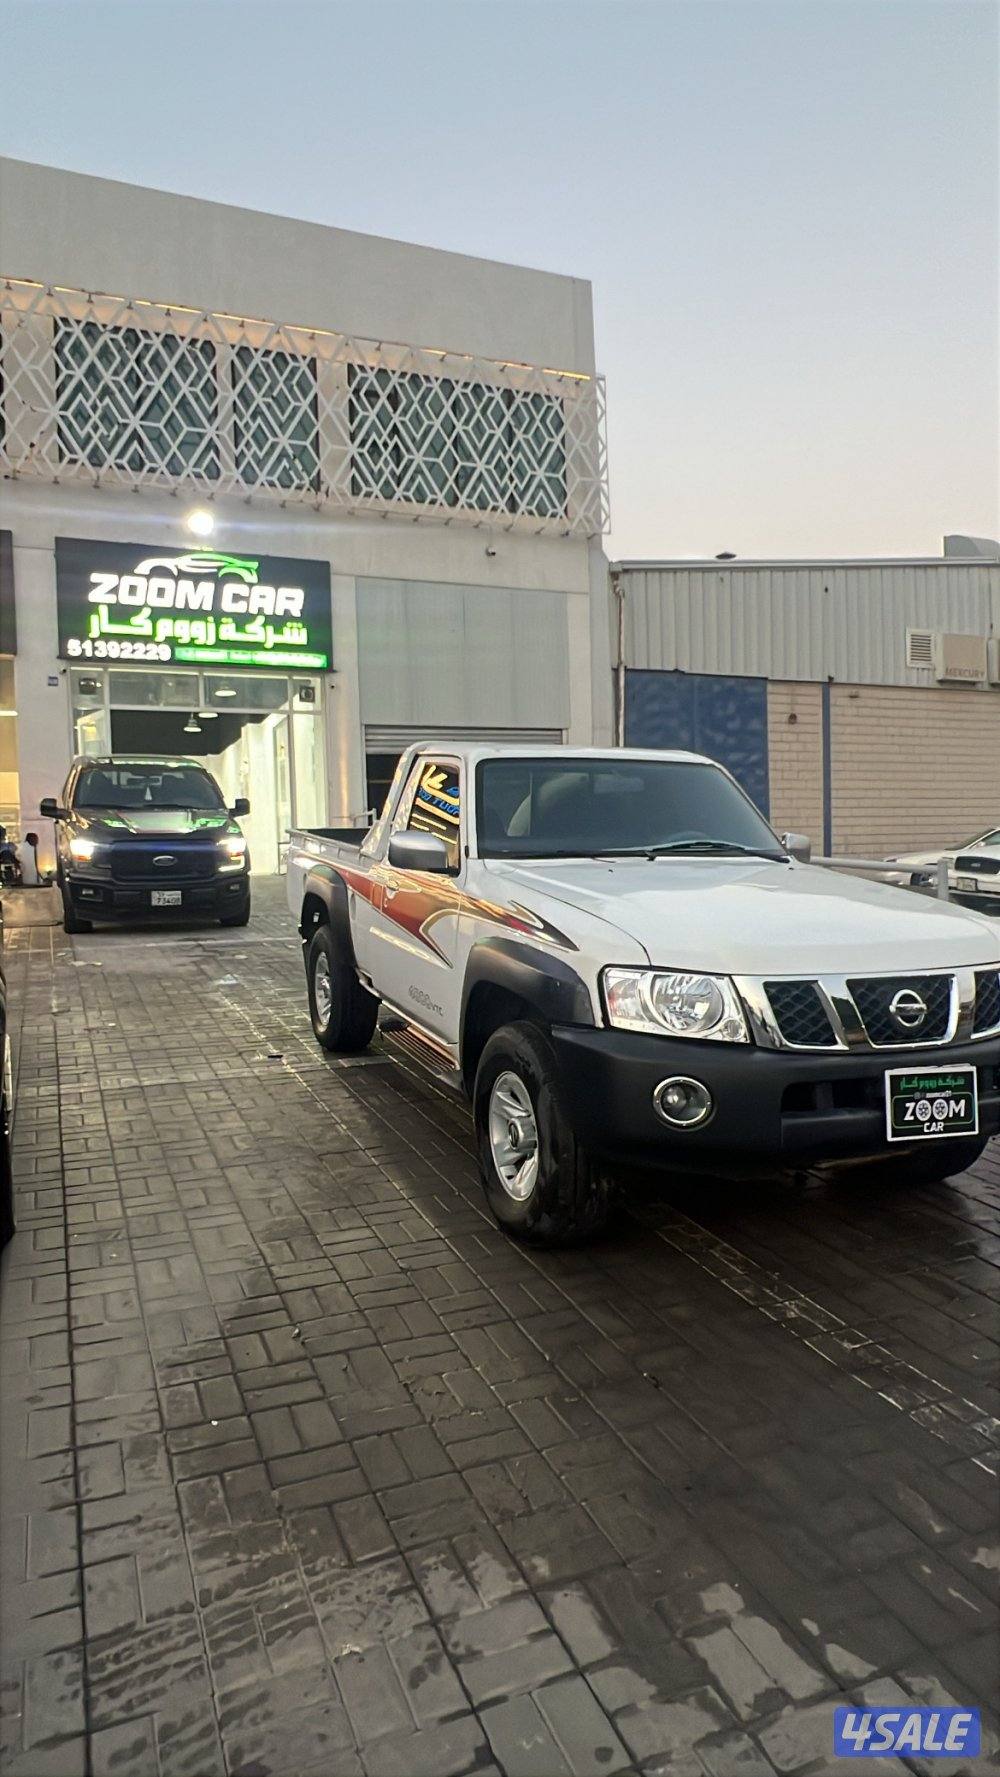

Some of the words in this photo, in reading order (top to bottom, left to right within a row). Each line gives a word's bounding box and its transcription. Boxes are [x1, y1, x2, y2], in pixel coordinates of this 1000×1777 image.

[87, 572, 215, 611] ZOOM
[221, 583, 305, 618] CAR
[88, 604, 153, 639] كار
[154, 616, 217, 645] زووم
[218, 615, 308, 649] شركة
[66, 638, 172, 662] 51392229
[945, 667, 985, 678] MERCURY
[903, 1098, 966, 1122] ZOOM
[923, 1122, 945, 1133] CAR
